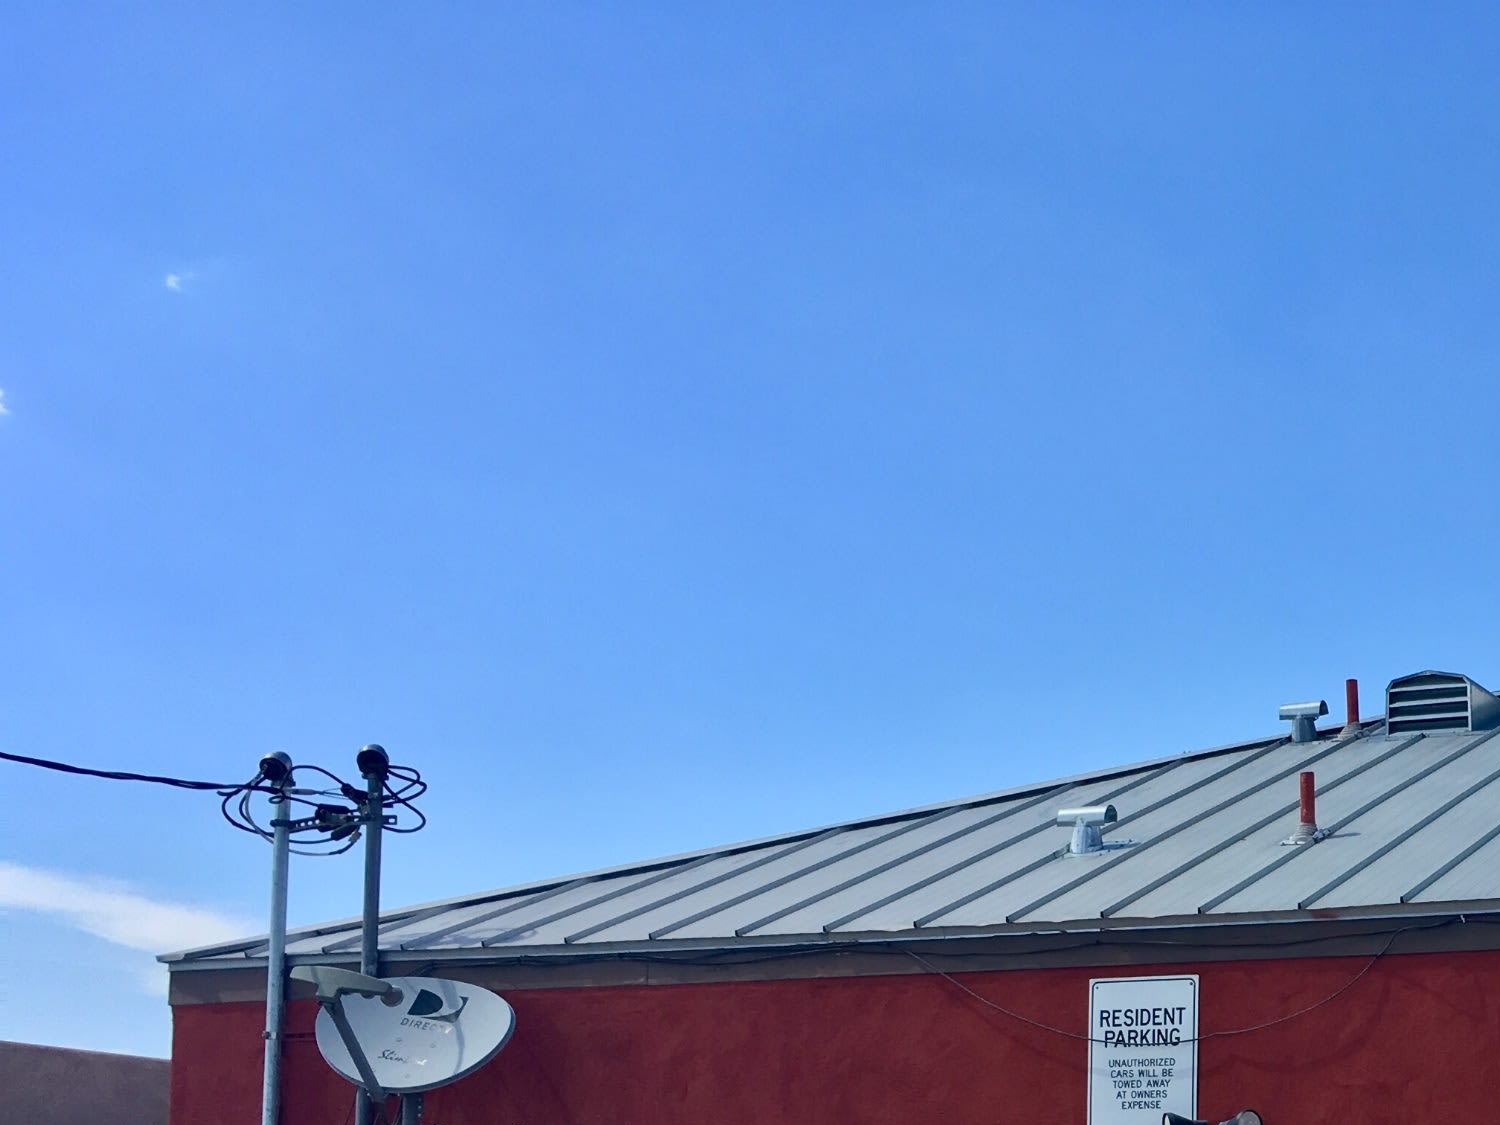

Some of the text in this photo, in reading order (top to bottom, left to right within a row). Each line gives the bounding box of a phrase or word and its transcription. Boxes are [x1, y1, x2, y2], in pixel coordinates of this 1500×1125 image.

[1100, 1007, 1186, 1028] RESIDENT
[1104, 1028, 1181, 1048] PARKING
[1108, 1058, 1176, 1068] UNAUTHORIZED
[1110, 1068, 1174, 1079] CARS WILL BE
[1113, 1079, 1171, 1089] TOWED AWAY
[1116, 1089, 1168, 1100] AT OWNERS
[1121, 1100, 1161, 1110] EXPENSE
